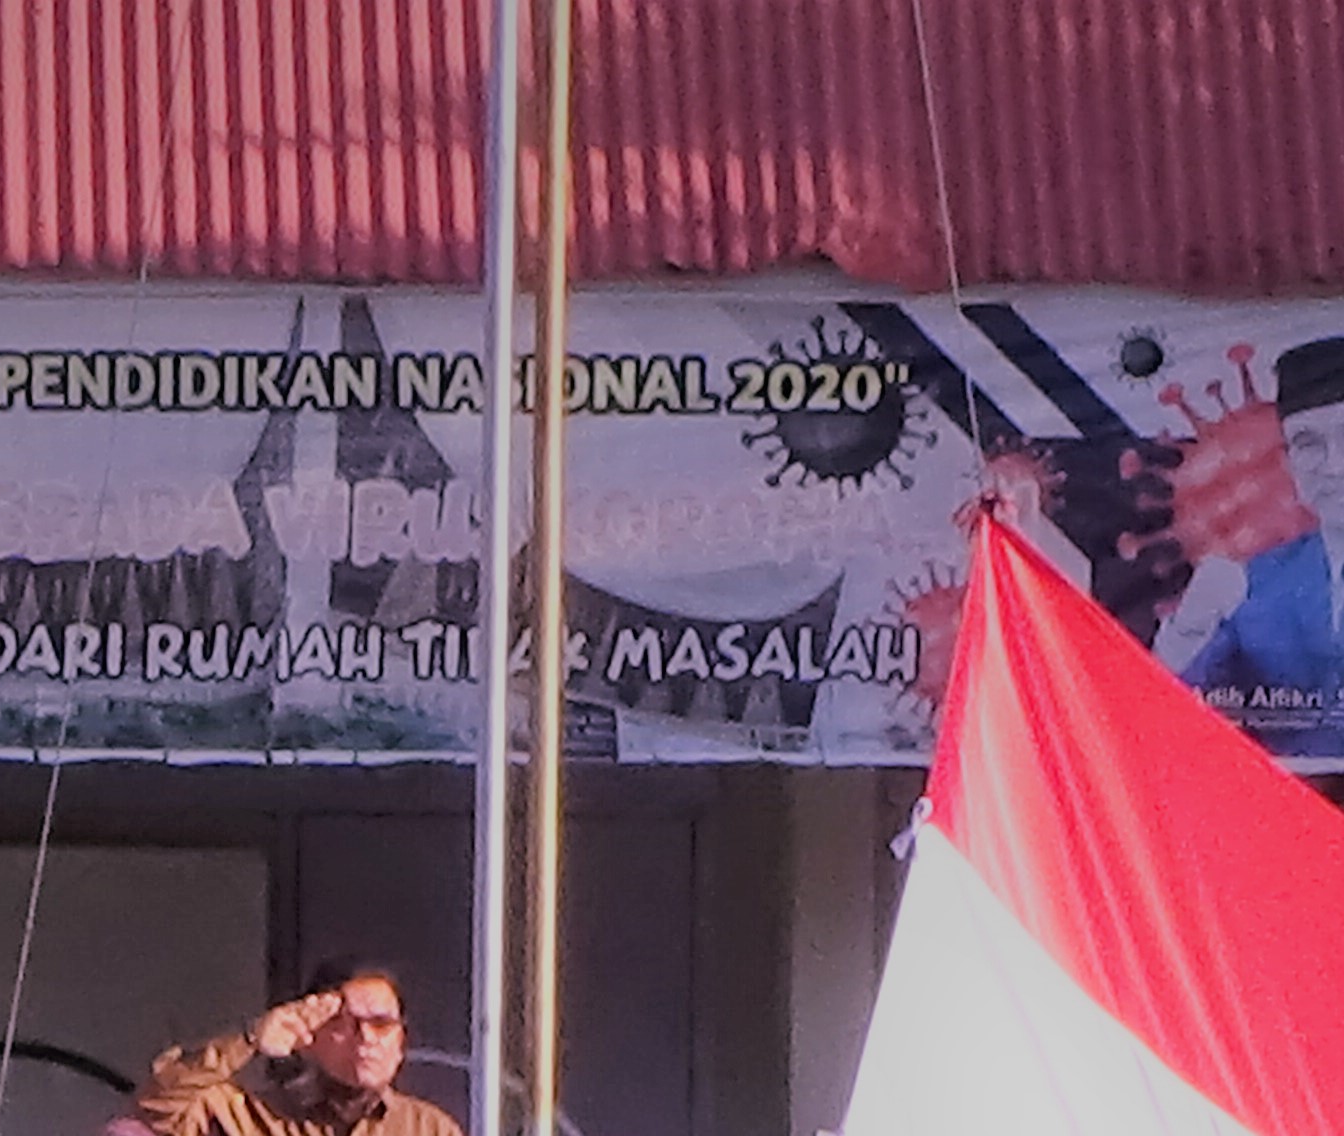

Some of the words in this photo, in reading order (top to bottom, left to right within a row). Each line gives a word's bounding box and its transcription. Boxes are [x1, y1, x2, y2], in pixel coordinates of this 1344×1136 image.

[392, 350, 722, 414] NAIONAL
[143, 616, 386, 684] RUMAH
[605, 618, 922, 684] MASALAH
